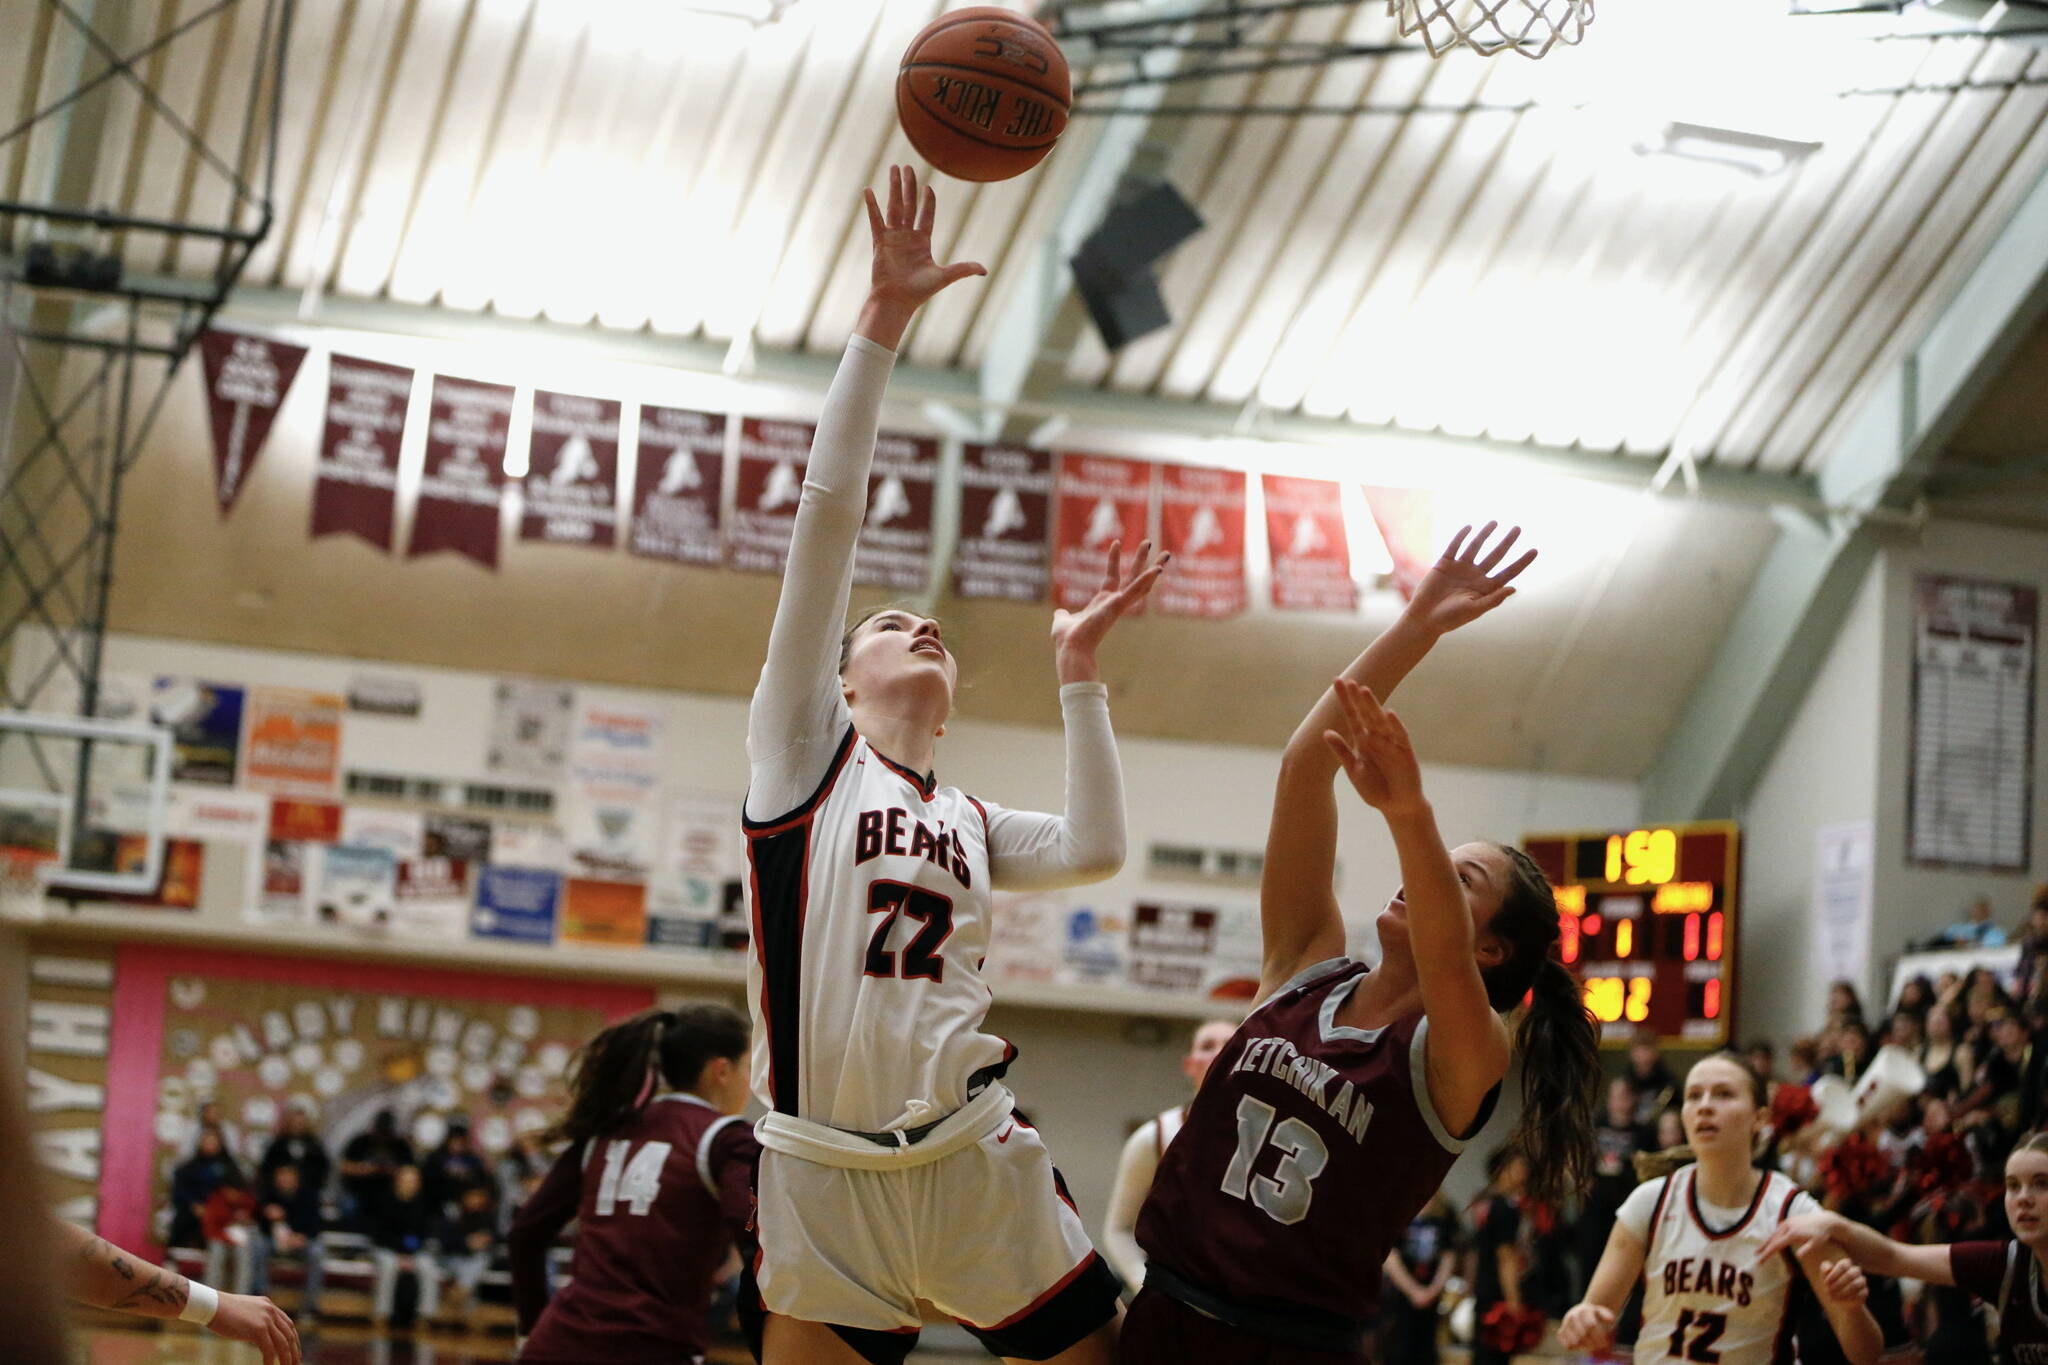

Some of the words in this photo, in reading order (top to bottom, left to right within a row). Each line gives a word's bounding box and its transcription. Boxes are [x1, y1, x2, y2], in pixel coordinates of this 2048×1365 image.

[932, 76, 1002, 131] ROCK
[1005, 98, 1053, 137] THE
[863, 879, 954, 983] 22
[595, 1139, 673, 1217] 14
[1220, 1093, 1329, 1226] 13
[1663, 1256, 1754, 1308] BEARS
[1667, 1307, 1728, 1365] 12
